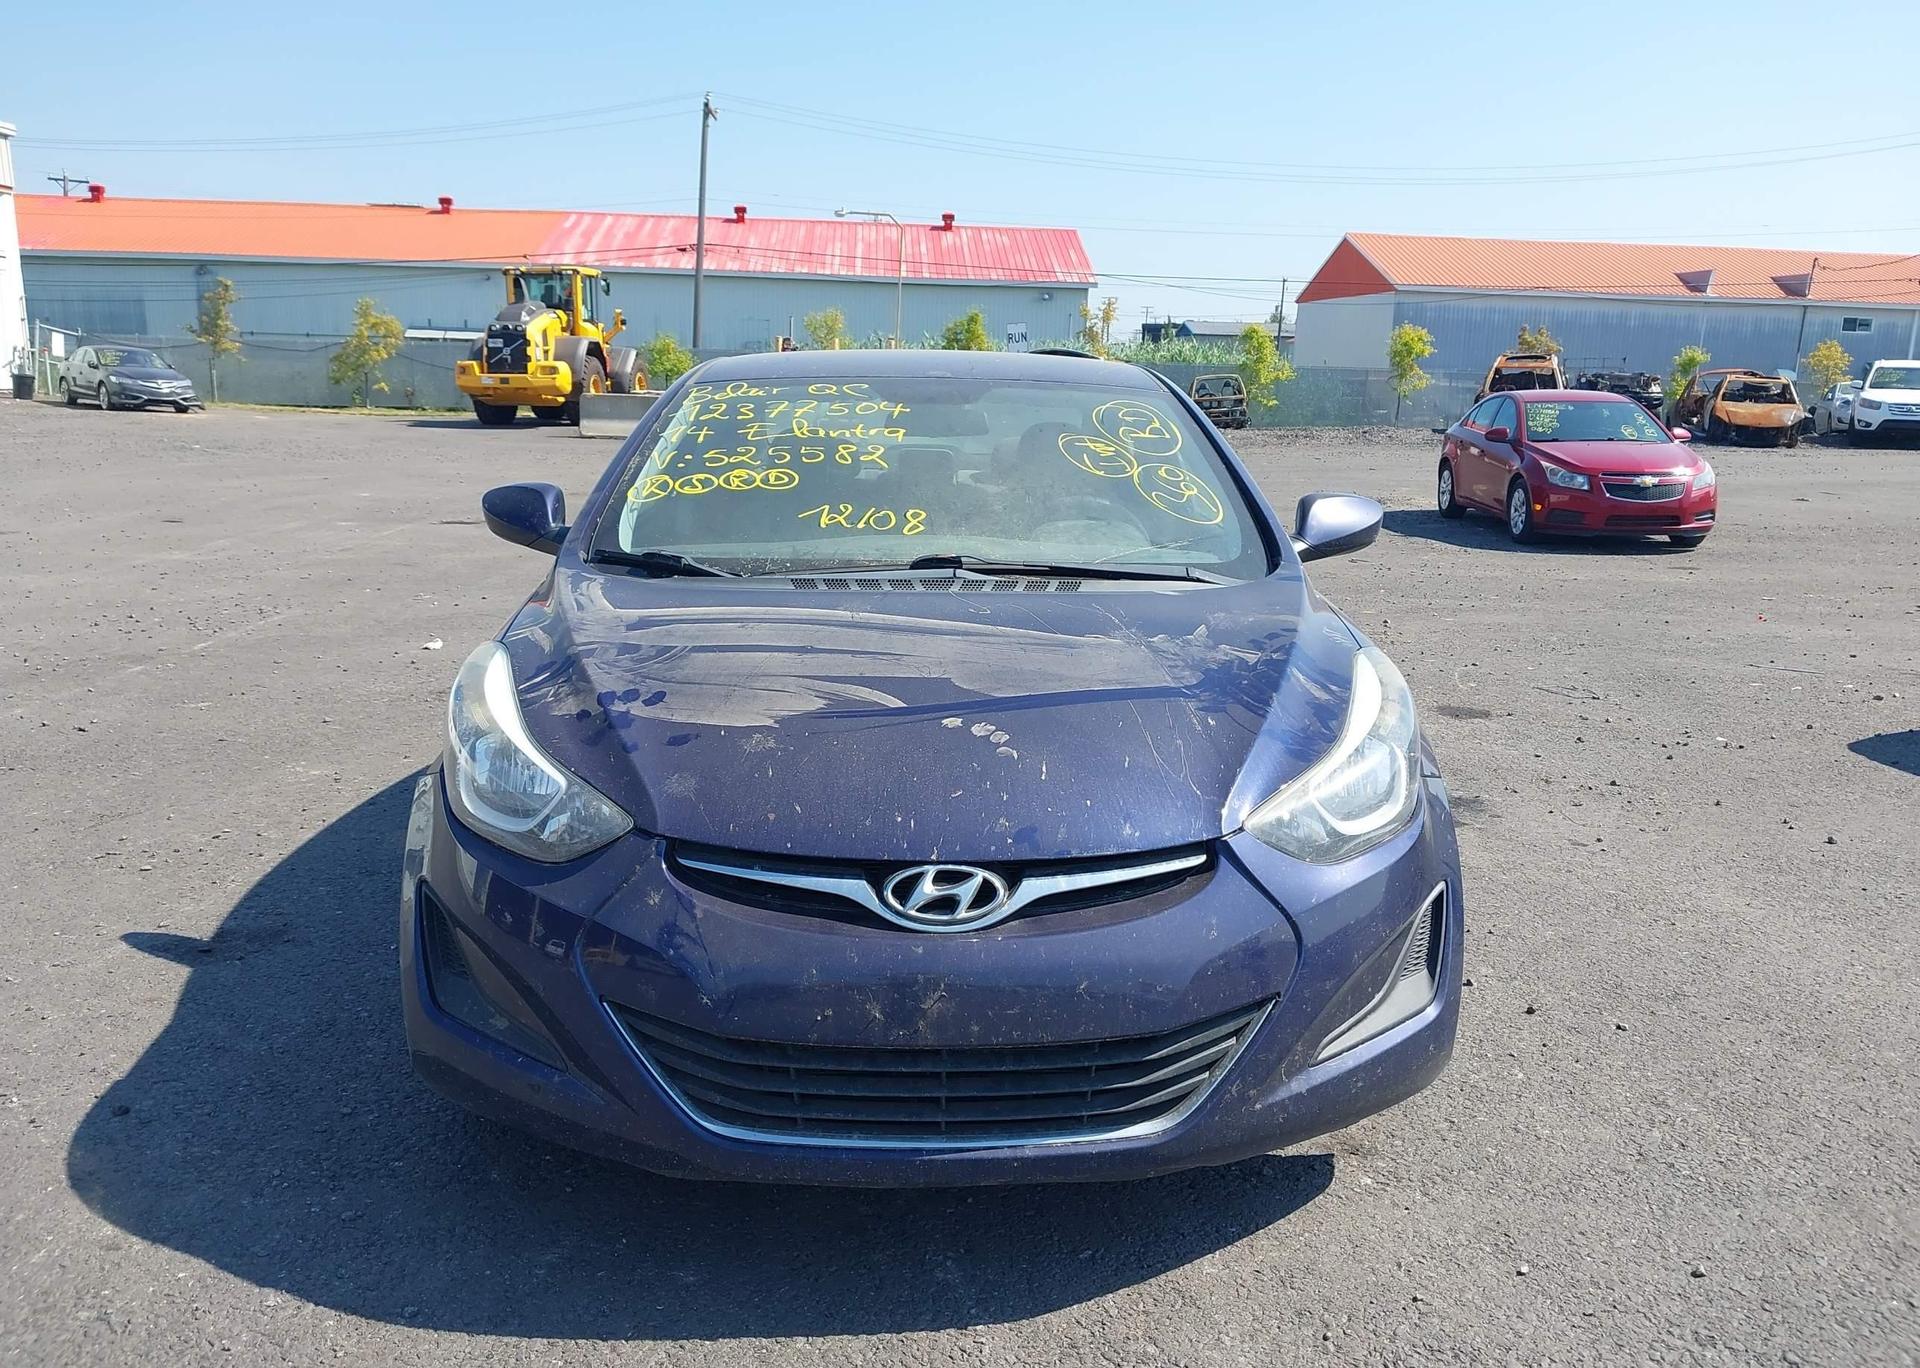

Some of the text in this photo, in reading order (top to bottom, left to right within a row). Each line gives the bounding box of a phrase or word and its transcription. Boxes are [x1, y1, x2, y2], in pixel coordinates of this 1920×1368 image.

[1008, 332, 1028, 344] RUN
[808, 383, 869, 398] QC
[737, 418, 906, 442] Elantra
